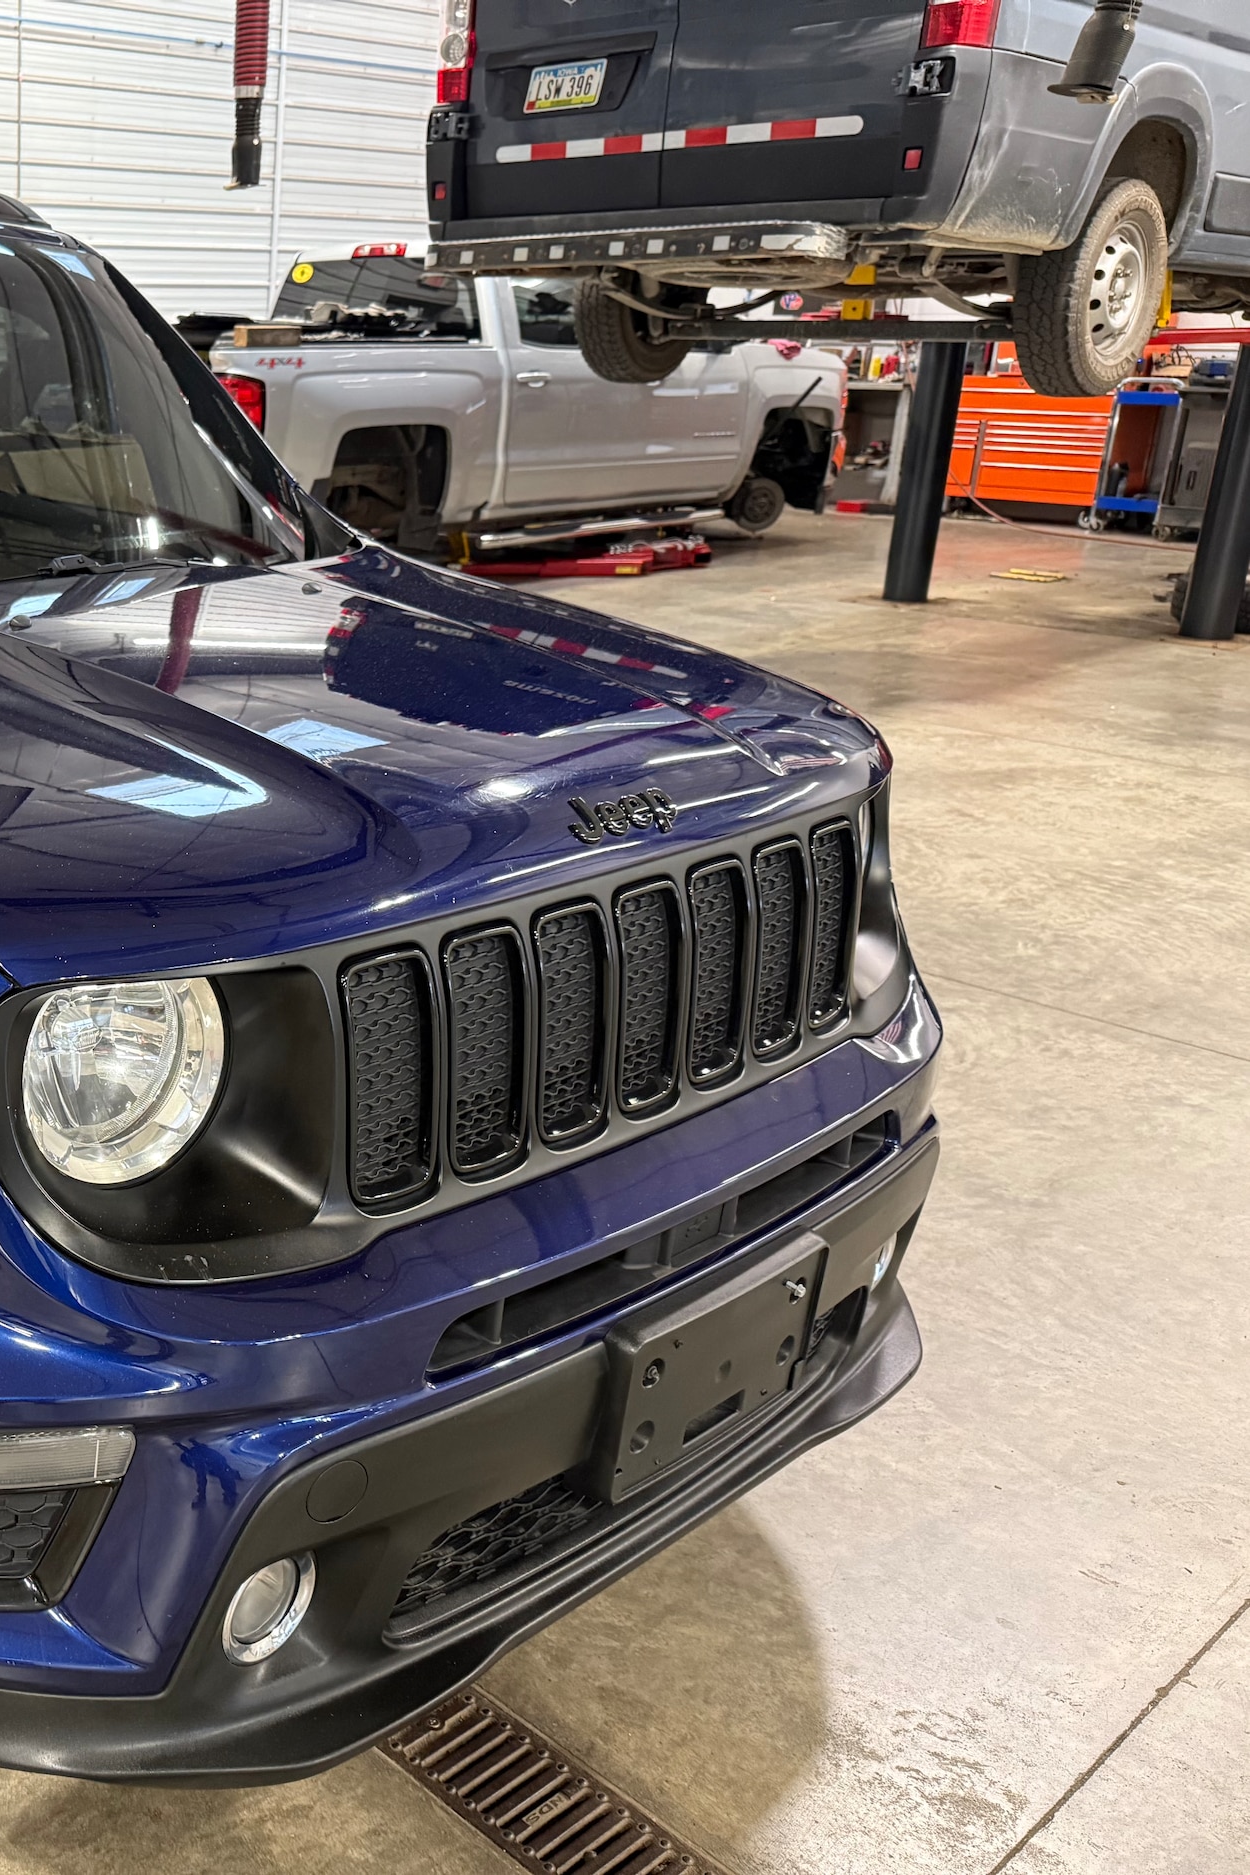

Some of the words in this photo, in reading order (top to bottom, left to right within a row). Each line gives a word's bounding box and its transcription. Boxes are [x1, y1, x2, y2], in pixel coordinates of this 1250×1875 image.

[536, 78, 565, 102] LSW
[566, 74, 594, 98] 396
[568, 787, 678, 845] Jeep
[525, 1795, 564, 1824] NDS
